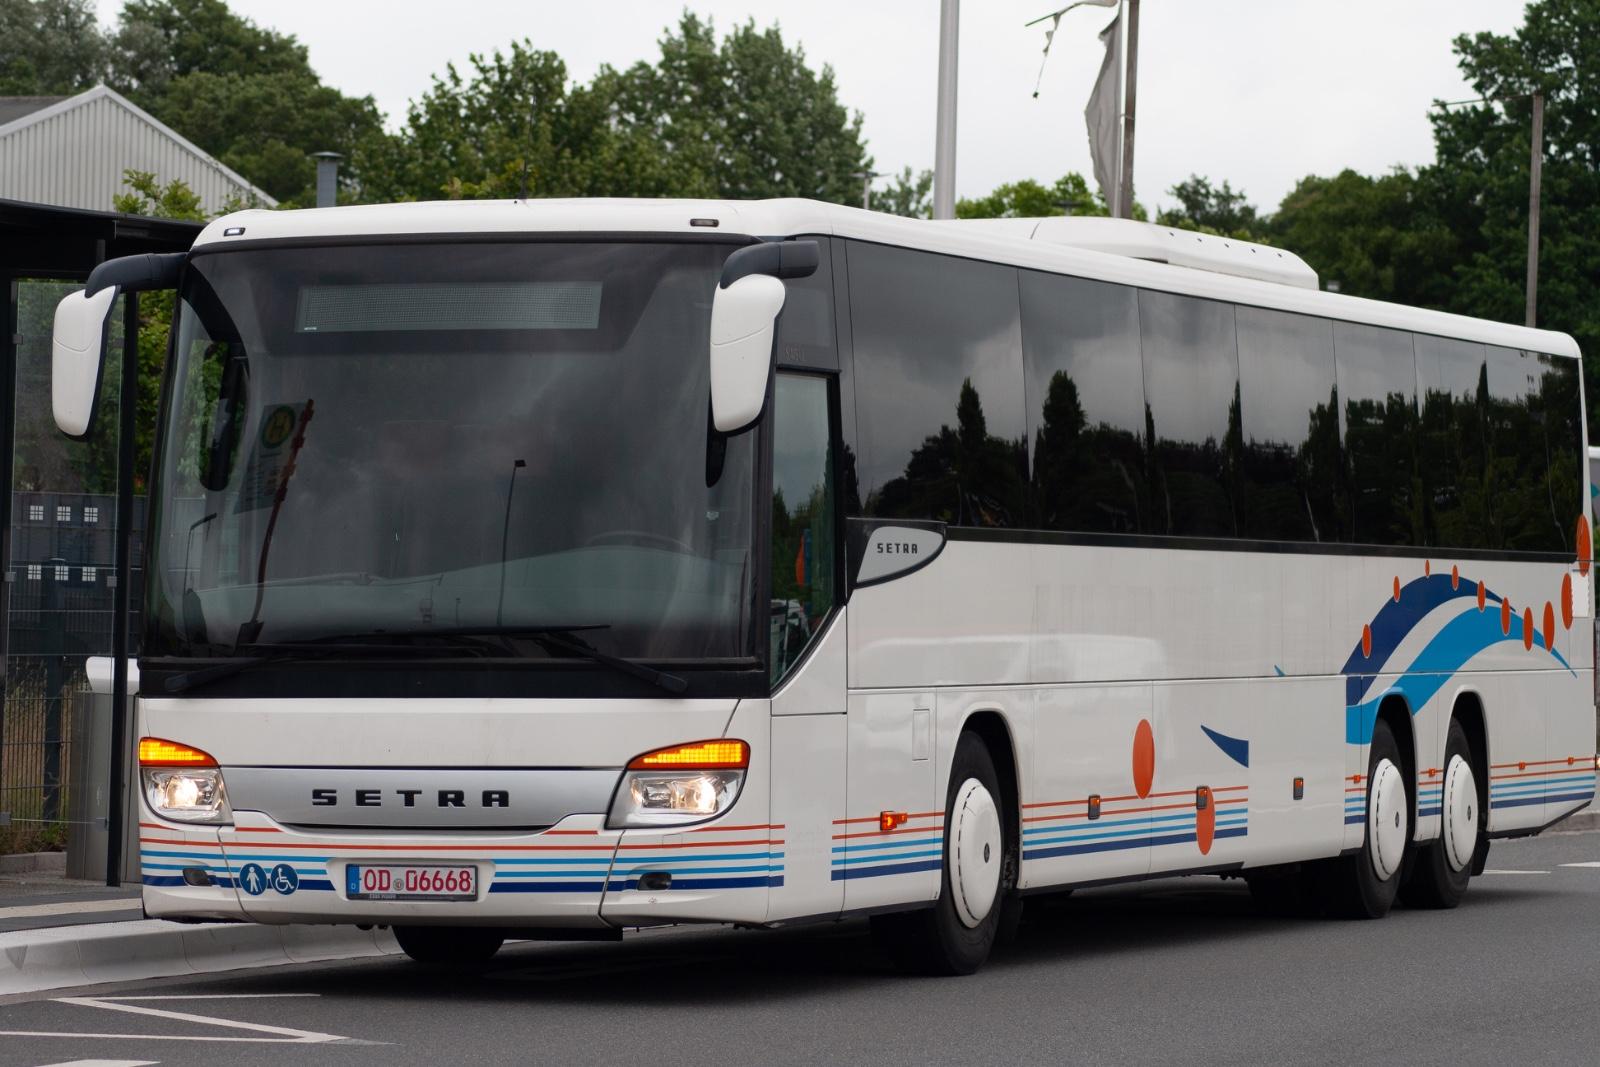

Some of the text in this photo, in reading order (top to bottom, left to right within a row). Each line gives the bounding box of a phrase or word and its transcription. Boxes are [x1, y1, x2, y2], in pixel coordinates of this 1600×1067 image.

[877, 543, 918, 554] SETRA
[312, 789, 509, 807] SETRA
[364, 869, 471, 892] OD 06668
